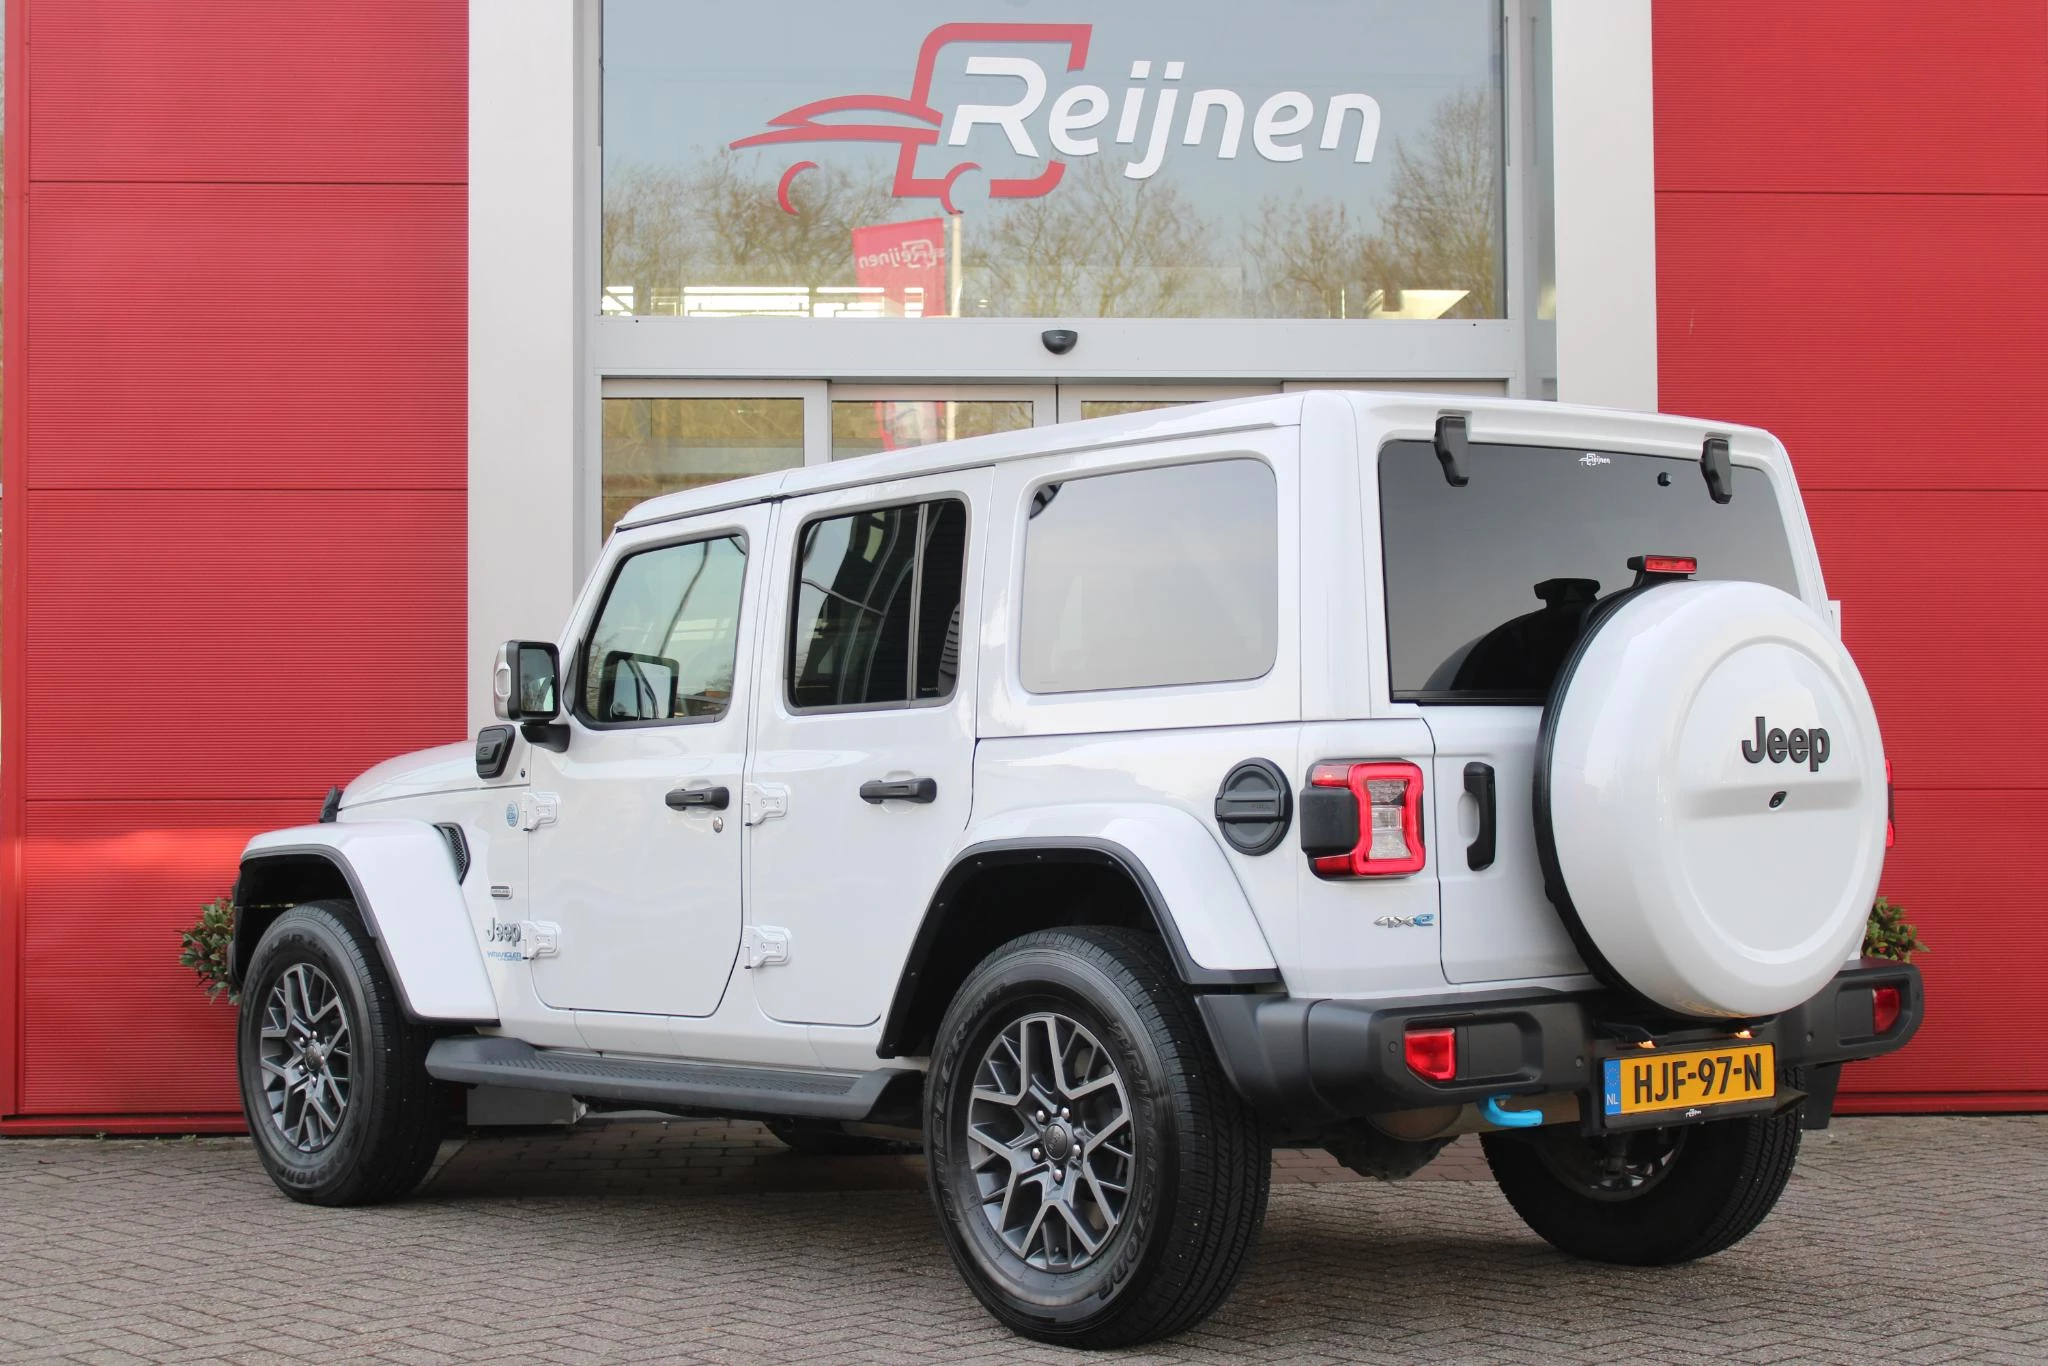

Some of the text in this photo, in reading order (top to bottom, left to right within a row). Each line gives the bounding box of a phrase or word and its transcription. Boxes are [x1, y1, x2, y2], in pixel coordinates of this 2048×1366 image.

[948, 56, 1382, 180] Reijnen
[1742, 716, 1830, 772] Jeep
[487, 917, 522, 947] Jeep
[1606, 1093, 1619, 1106] NL
[1634, 1053, 1762, 1104] HJF-97-N
